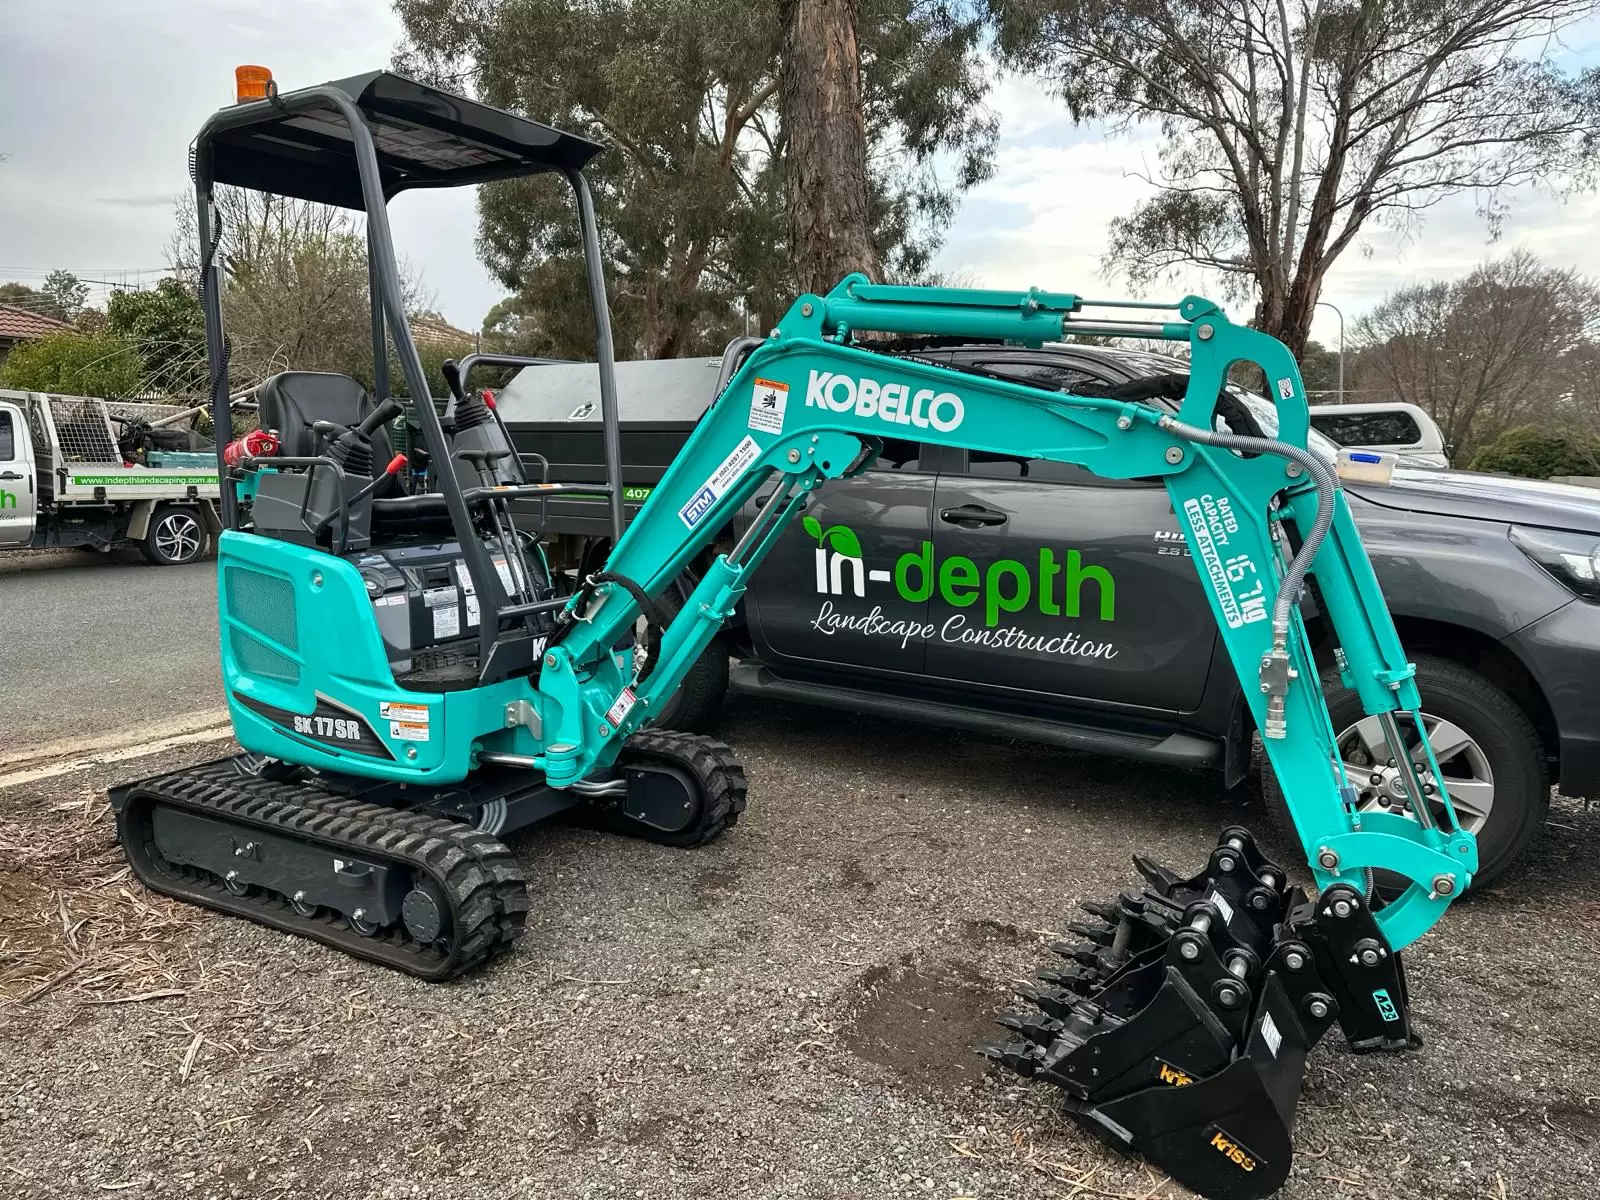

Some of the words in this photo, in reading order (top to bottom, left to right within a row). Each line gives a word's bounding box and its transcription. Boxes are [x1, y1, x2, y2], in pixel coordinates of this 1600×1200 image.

[805, 369, 965, 432] KOBELCO
[80, 476, 217, 485] www.indepthlandscaping.com.au
[719, 466, 730, 478] (02)
[739, 440, 752, 455] 1500
[626, 488, 650, 499] 407
[686, 490, 712, 519] STM
[1216, 496, 1239, 534] RATED
[1200, 493, 1230, 546] CAPACITY
[815, 540, 1116, 628] in-depth
[1187, 503, 1206, 533] LESS
[1198, 535, 1239, 622] ATTACHMENTS
[810, 600, 936, 649] Landscape
[940, 613, 1119, 660] Construction
